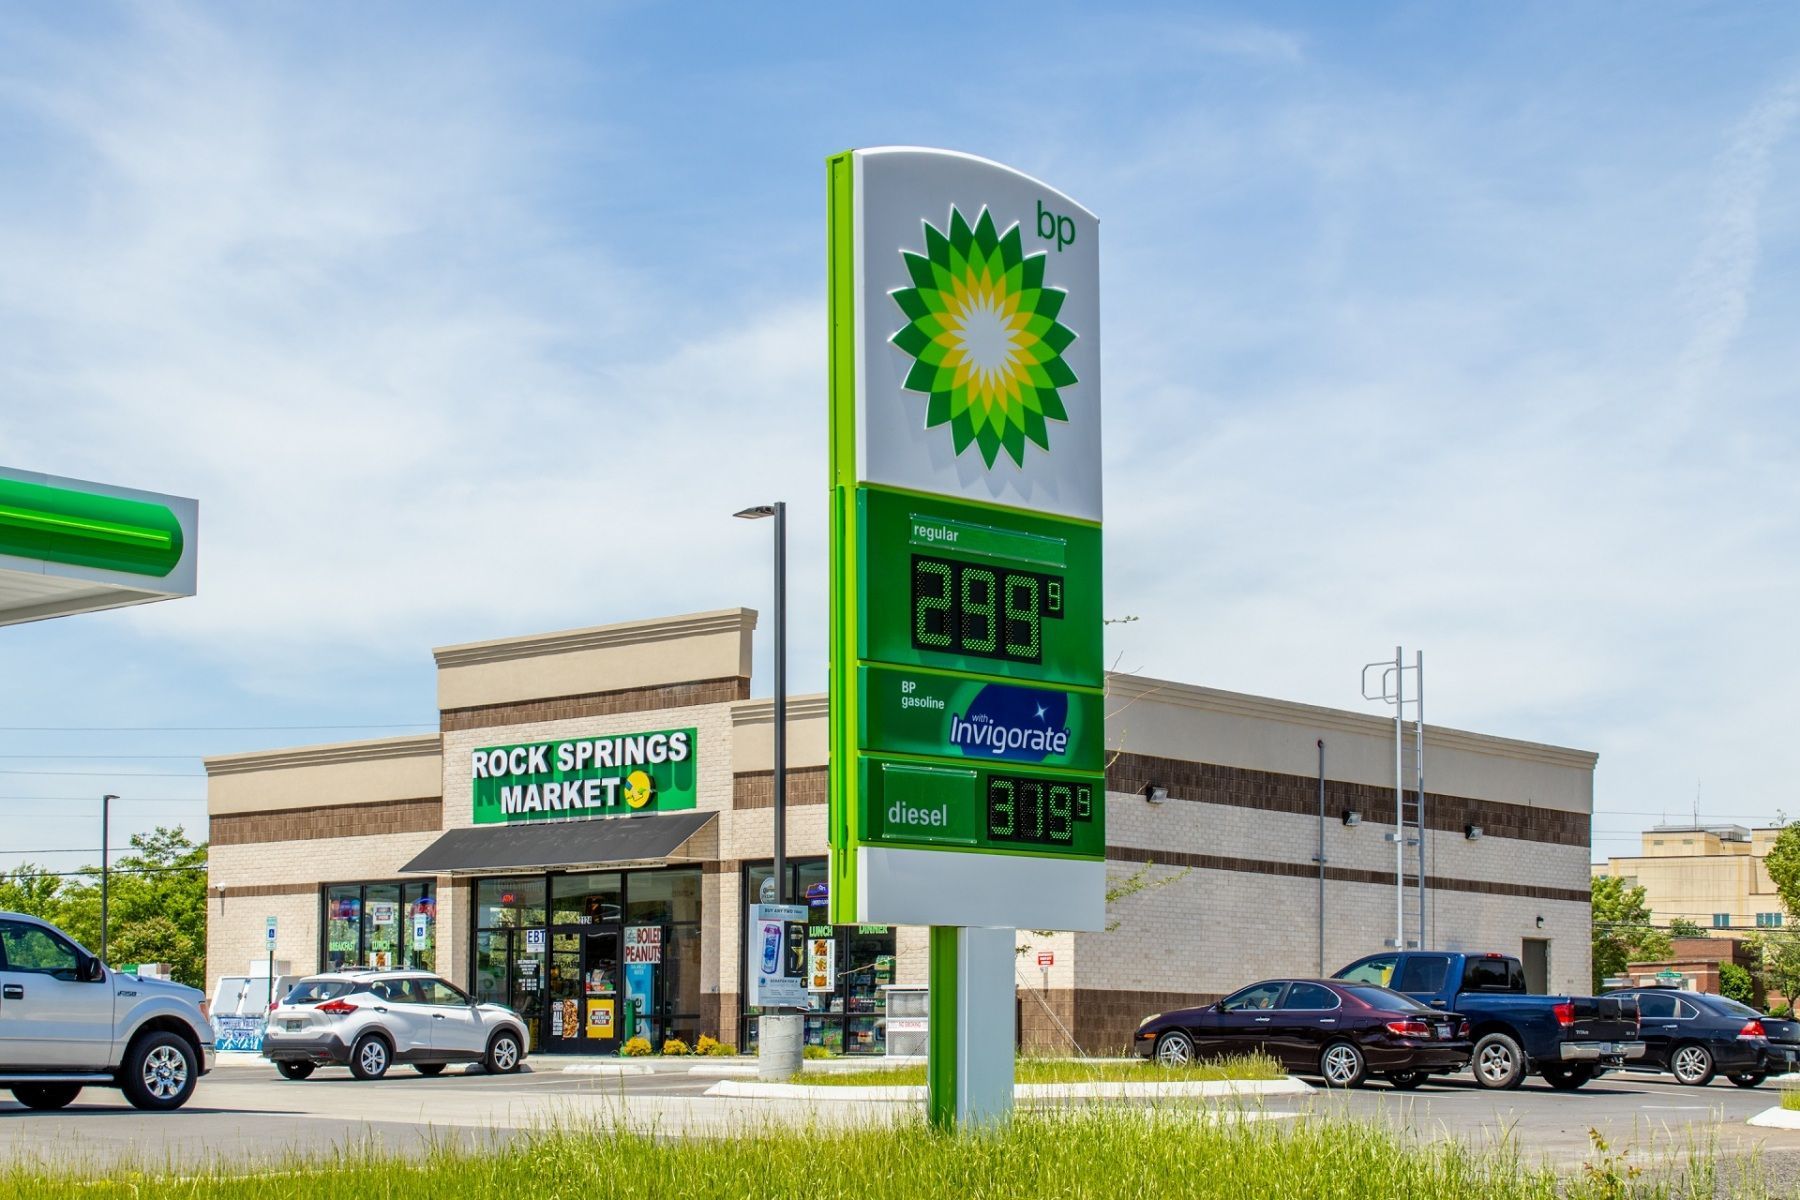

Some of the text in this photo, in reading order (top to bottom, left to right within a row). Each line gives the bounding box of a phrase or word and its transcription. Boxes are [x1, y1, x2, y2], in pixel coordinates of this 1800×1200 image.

[1037, 199, 1075, 252] bp
[913, 523, 959, 543] regular
[916, 560, 1040, 658] 299
[901, 680, 916, 694] BP
[901, 696, 945, 710] gasoline
[971, 713, 989, 723] with
[950, 715, 1067, 754] Invigorate
[471, 731, 689, 779] ROCK SPRINGS
[500, 776, 621, 815] MARKET
[887, 801, 948, 827] diesel
[502, 894, 514, 903] ATM
[528, 930, 545, 943] EBT
[637, 928, 661, 944] BOILED
[809, 926, 833, 937] LUNCH
[859, 925, 889, 934] DINNER
[371, 940, 390, 950] LUNCH
[625, 944, 662, 963] PEANUTS
